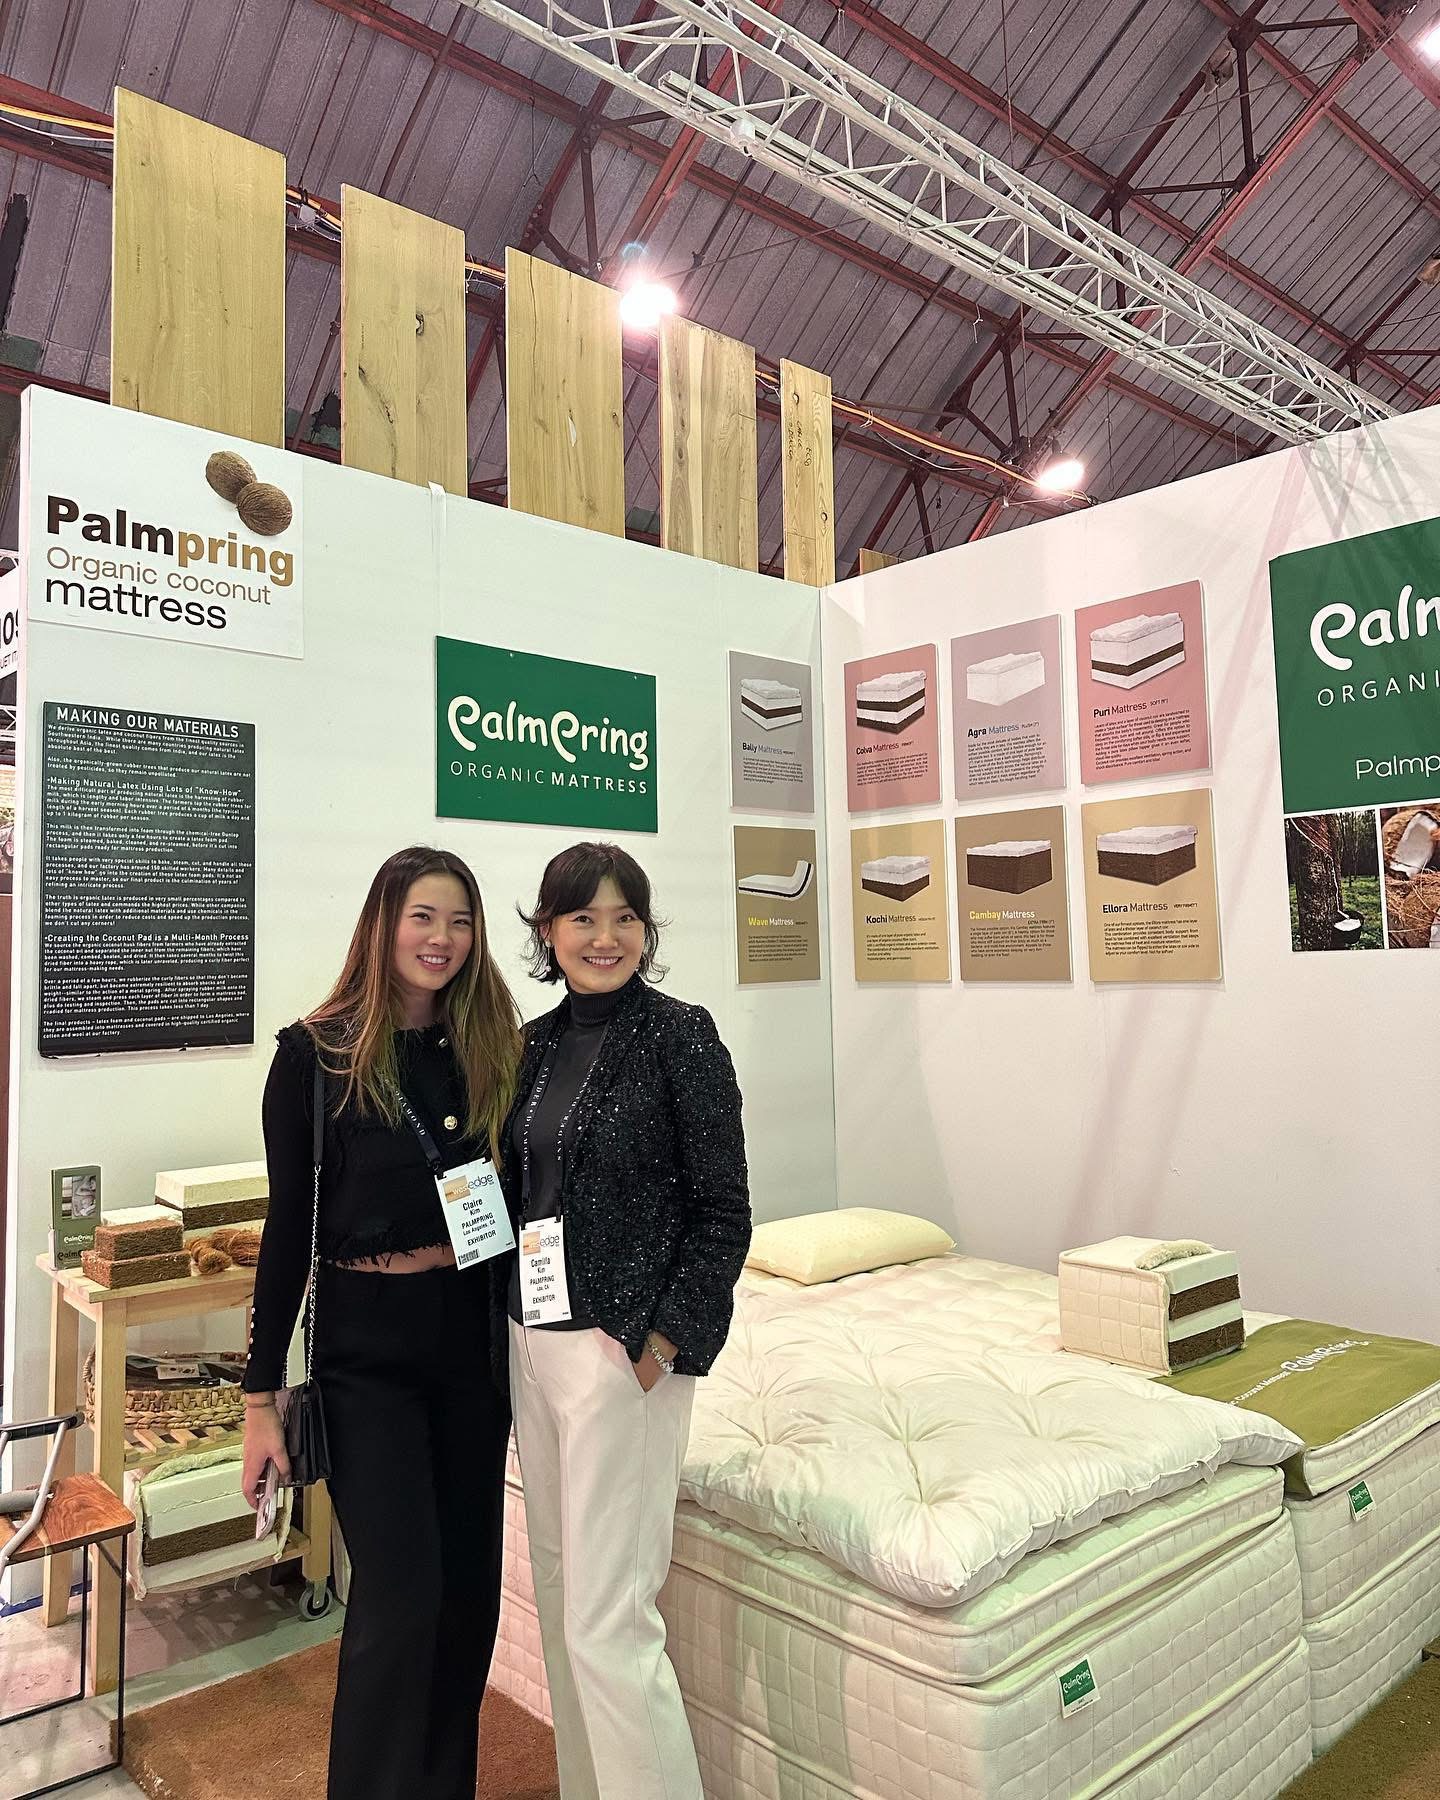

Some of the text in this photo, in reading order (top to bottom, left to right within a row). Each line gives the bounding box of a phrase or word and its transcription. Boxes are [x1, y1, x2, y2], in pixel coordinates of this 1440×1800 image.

[47, 495, 294, 587] Palmpring
[47, 546, 271, 605] Organic coconut
[46, 578, 227, 629] mattress
[1093, 707, 1111, 718] Puri
[1111, 701, 1147, 715] Mattress
[57, 706, 239, 738] MAKING OUR MATERIALS
[967, 728, 987, 739] Agra
[988, 723, 1019, 735] Mattress
[758, 744, 783, 755] Mattress
[856, 747, 872, 756] Colva
[873, 742, 900, 753] Mattress
[450, 761, 647, 794] ORGANIC MATTRESS
[83, 778, 114, 788] Natural
[117, 781, 138, 789] Latex
[141, 783, 163, 792] Using
[166, 784, 183, 792] Lots
[1102, 903, 1128, 914] Ellora
[1129, 902, 1169, 913] Mattress
[748, 916, 769, 926] Wave
[769, 917, 794, 926] Mattress
[866, 914, 888, 924] Kochi
[888, 914, 917, 924] Mattress
[969, 910, 1035, 921] Cambay Mattress
[102, 933, 135, 941] Coconut
[137, 933, 152, 941] Pad
[154, 933, 160, 941] is
[462, 1198, 483, 1211] Claire
[469, 1207, 481, 1216] Kim
[461, 1212, 494, 1229] PALMPRING
[467, 1229, 497, 1246] EXHIBITOR
[532, 1294, 556, 1305] EXHIBITOR
